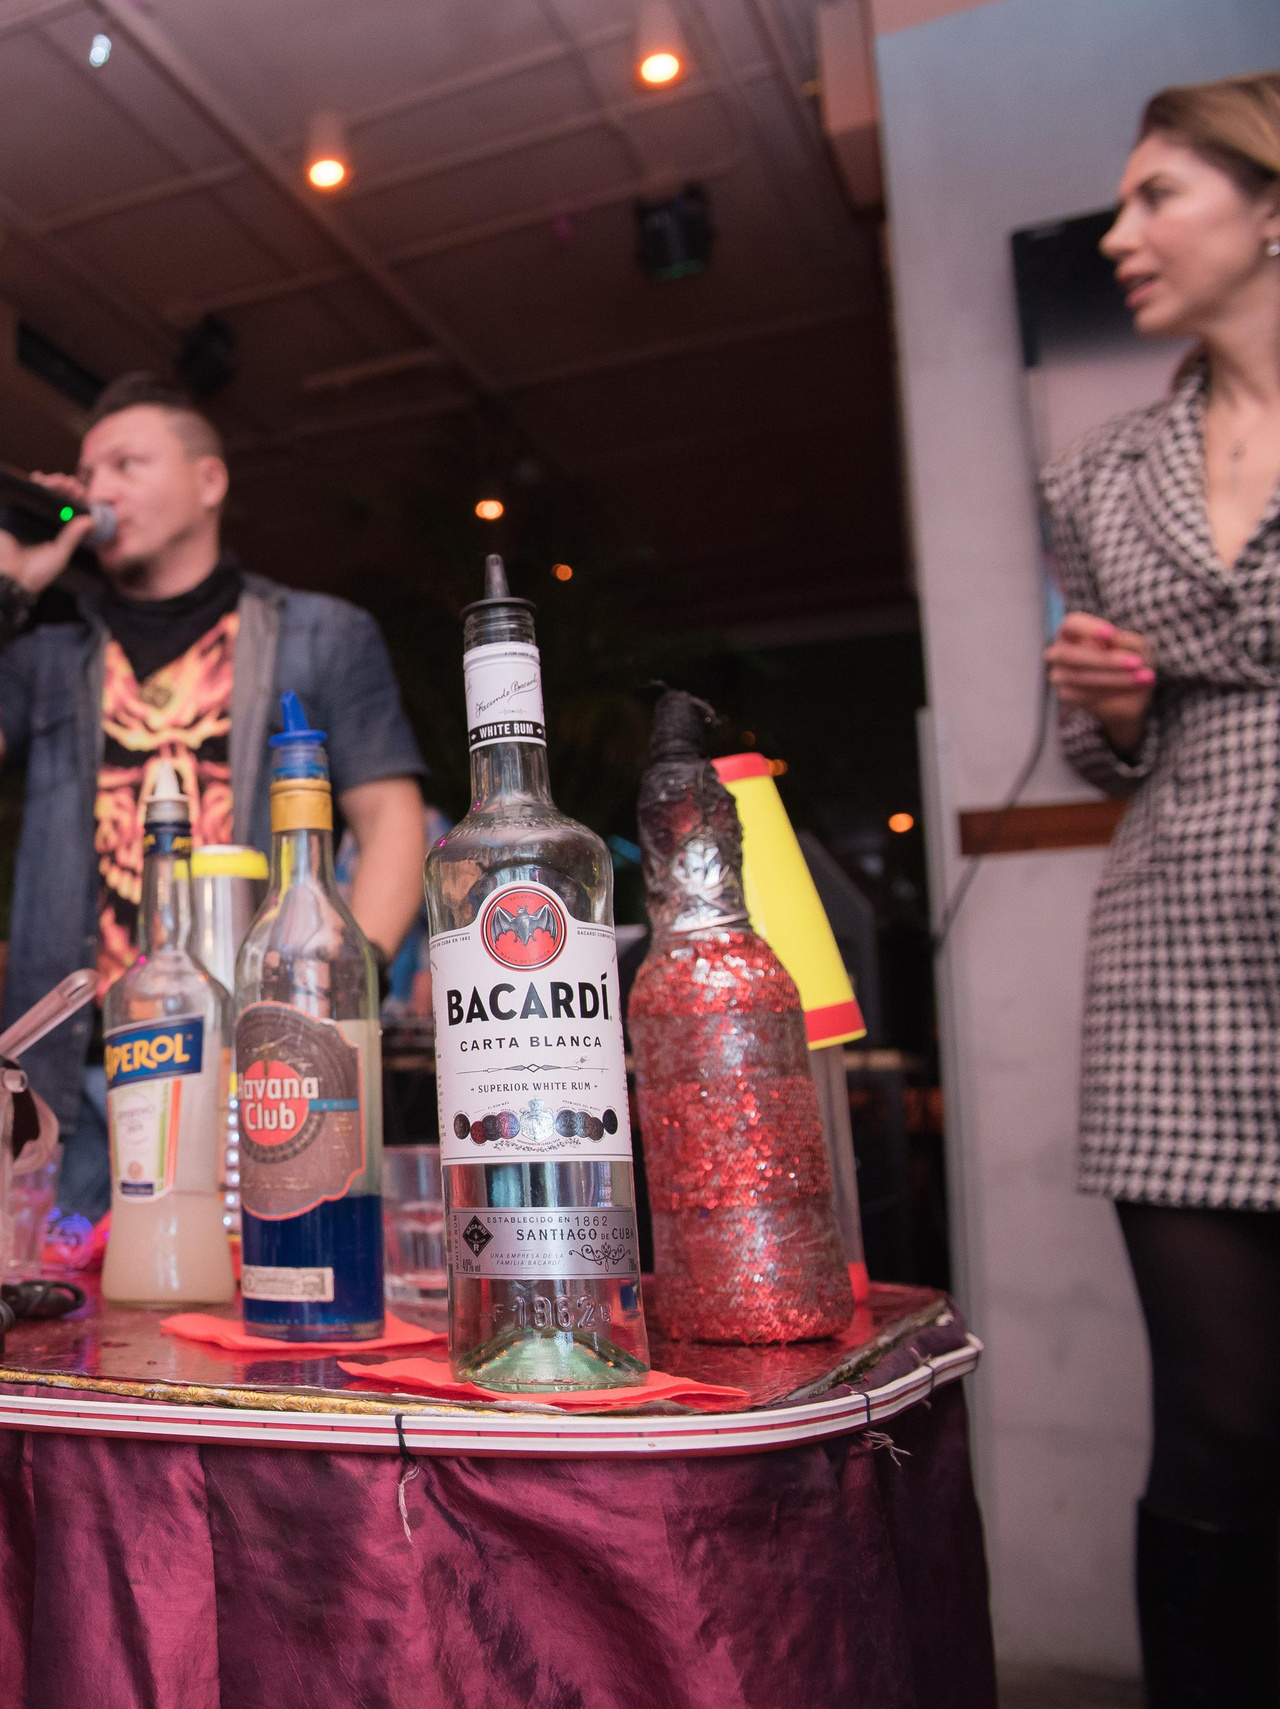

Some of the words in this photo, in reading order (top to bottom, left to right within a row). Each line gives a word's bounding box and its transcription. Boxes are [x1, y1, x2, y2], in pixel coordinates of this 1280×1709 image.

[480, 723, 511, 738] WHITE
[514, 723, 533, 735] RUM
[447, 972, 609, 1026] BACARDÍ
[460, 1038, 519, 1052] CARTA
[530, 1036, 601, 1047] BLANCA
[106, 1032, 190, 1081] PEROL
[478, 1083, 528, 1093] SUPERIOR
[533, 1082, 567, 1090] WHITE
[571, 1082, 591, 1090] RUM
[245, 1102, 296, 1130] Club
[486, 1216, 554, 1224] ESTABLECIDO
[574, 1215, 608, 1227] 1862
[516, 1228, 597, 1241] SANTIAGO
[611, 1227, 635, 1240] CUBA
[473, 1243, 480, 1252] R
[511, 1295, 598, 1332] 1862
